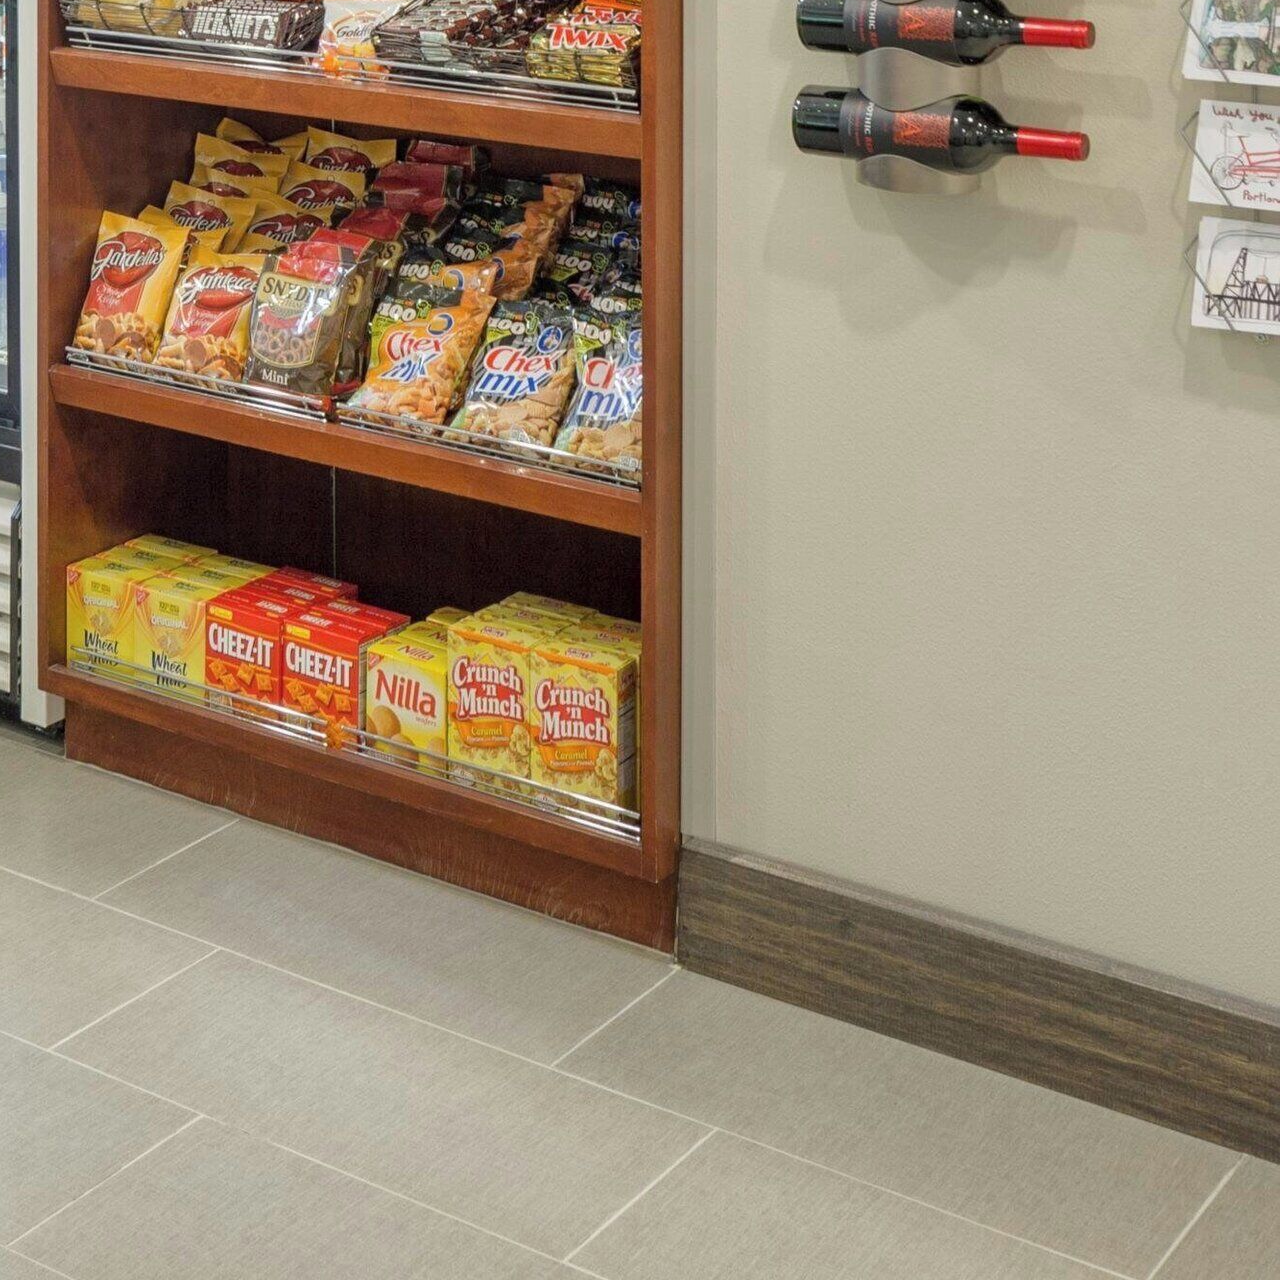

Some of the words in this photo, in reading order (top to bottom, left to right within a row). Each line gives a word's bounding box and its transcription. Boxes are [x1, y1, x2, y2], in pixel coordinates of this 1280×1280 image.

[191, 7, 280, 42] HERSHEY'S
[546, 23, 632, 53] TWIX
[386, 331, 454, 362] Chex
[485, 346, 566, 375] Chex
[262, 368, 289, 386] Mini
[479, 371, 550, 397] mix
[84, 629, 119, 654] Wheat
[207, 623, 275, 669] CHEEZ-IT
[401, 645, 435, 661] Nilla
[151, 650, 187, 676] Wheat
[286, 642, 354, 688] CHEEZ-IT
[453, 655, 523, 692] Crunch
[375, 669, 438, 718] Nilla
[459, 688, 524, 723] Munch
[536, 680, 610, 716] Crunch
[471, 726, 503, 737] Caramel
[542, 710, 610, 746] Munch
[555, 749, 588, 760] Caramel
